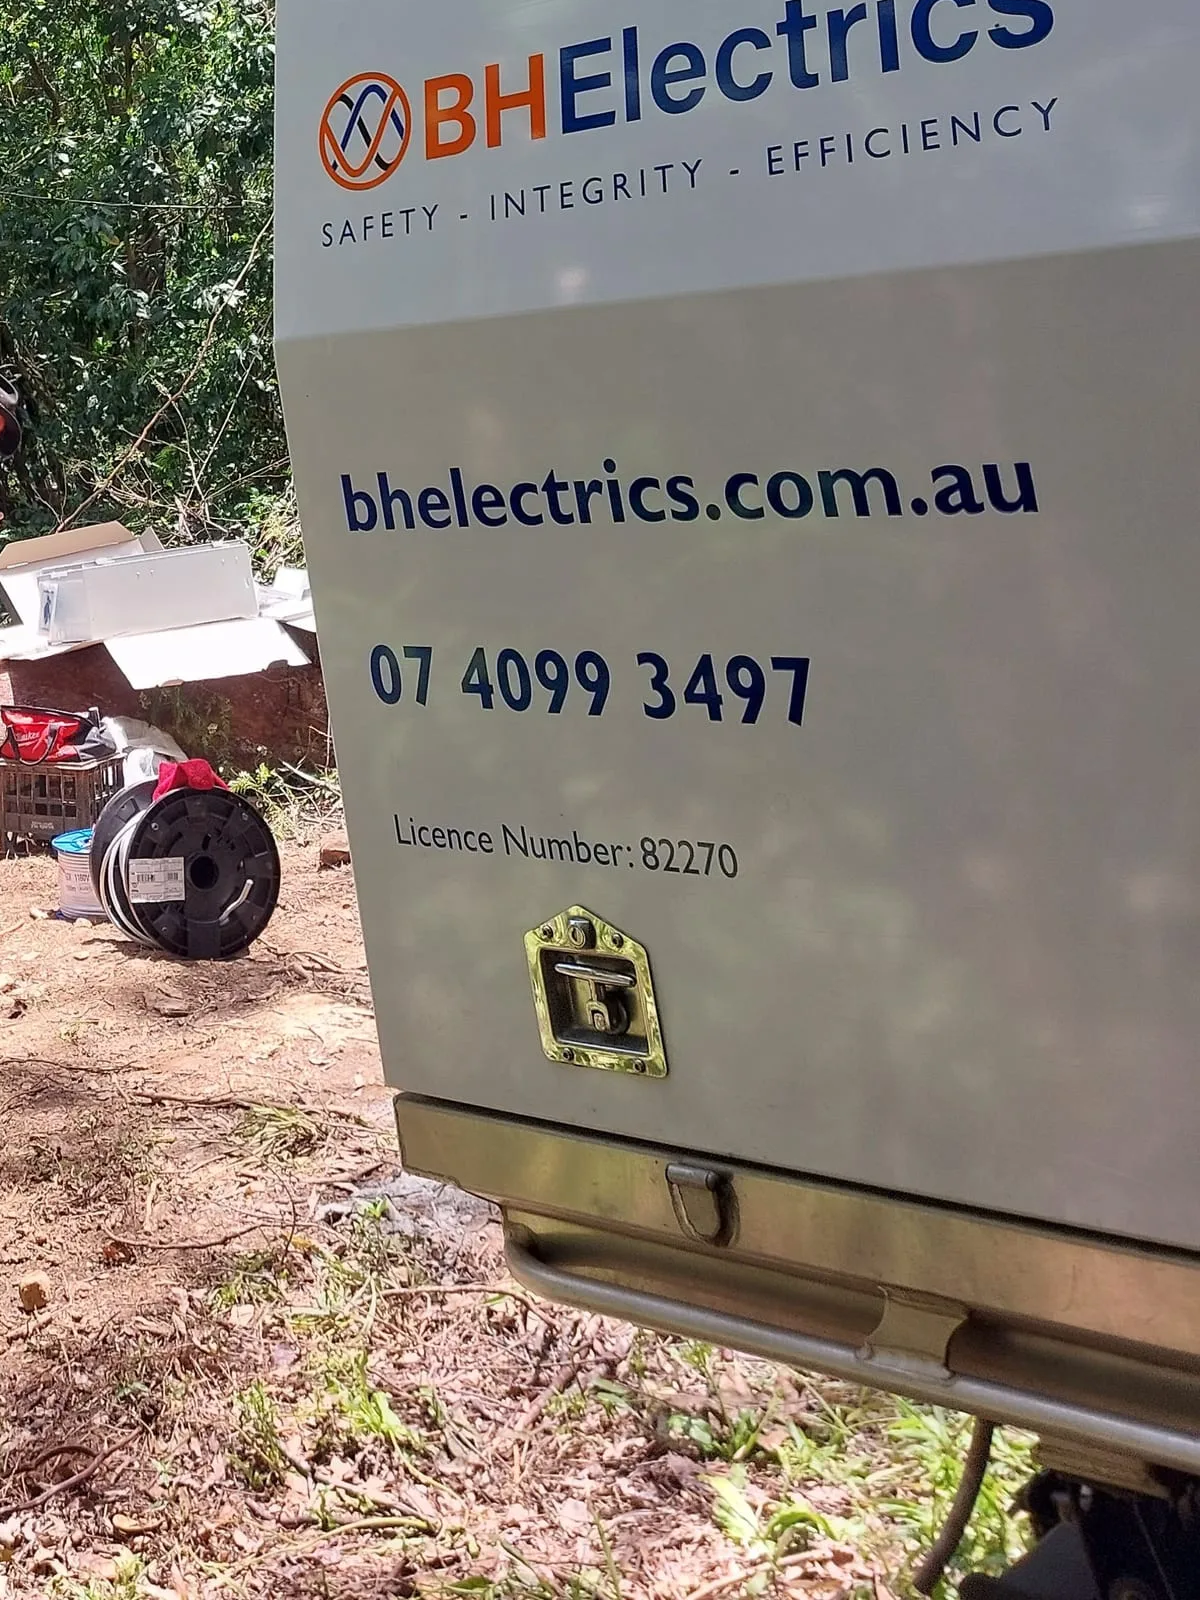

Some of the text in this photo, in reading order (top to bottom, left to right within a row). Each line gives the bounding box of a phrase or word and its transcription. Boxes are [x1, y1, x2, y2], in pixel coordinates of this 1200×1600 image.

[321, 203, 440, 248] SAFETY
[489, 158, 703, 222] INTEGRITY
[766, 97, 1059, 177] EFFICIENCY
[340, 458, 1039, 532] bhelectrics.com.au
[369, 644, 811, 727] 07 4099 3497
[393, 813, 738, 879] Licence Number: 82270
